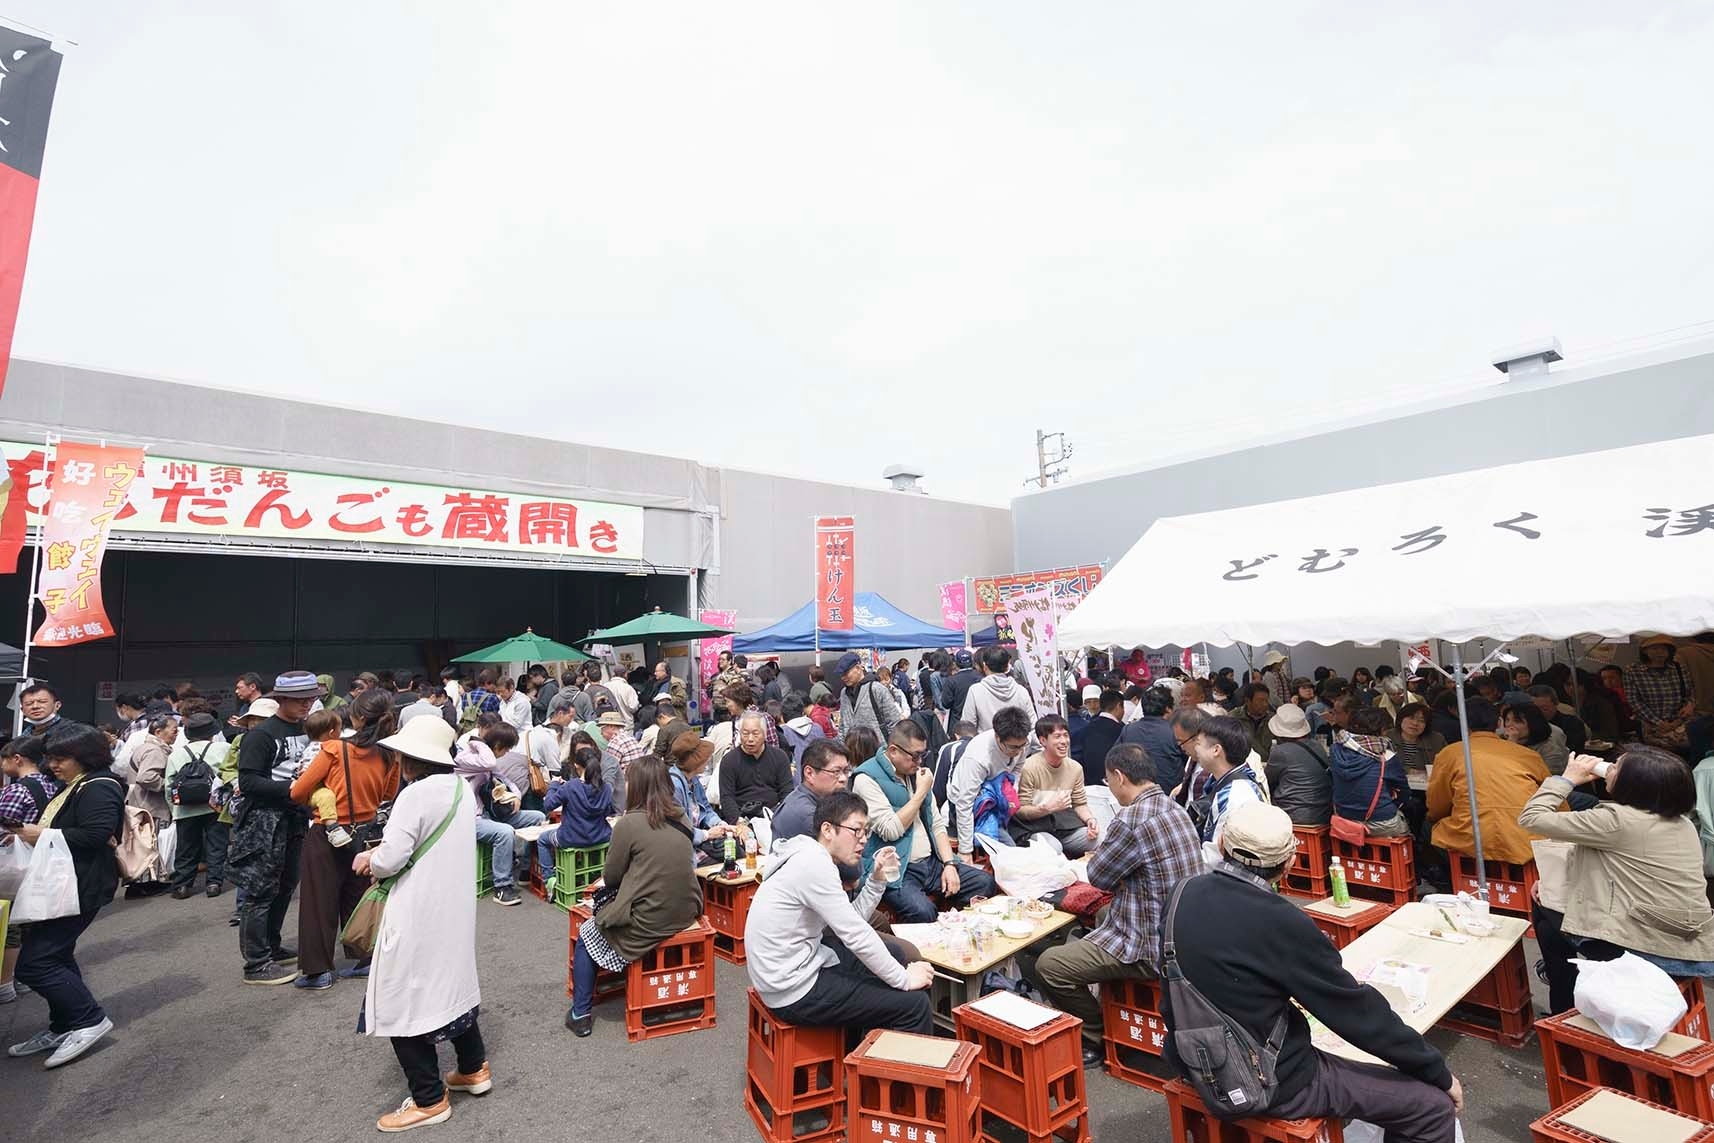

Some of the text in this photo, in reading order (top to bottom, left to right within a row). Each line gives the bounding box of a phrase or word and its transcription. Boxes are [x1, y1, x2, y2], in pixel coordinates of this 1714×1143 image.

[138, 462, 288, 489] 州須坂
[115, 481, 618, 553] だんごも蔵開き
[1222, 511, 1541, 581] どむろく
[827, 568, 844, 624] けん玉
